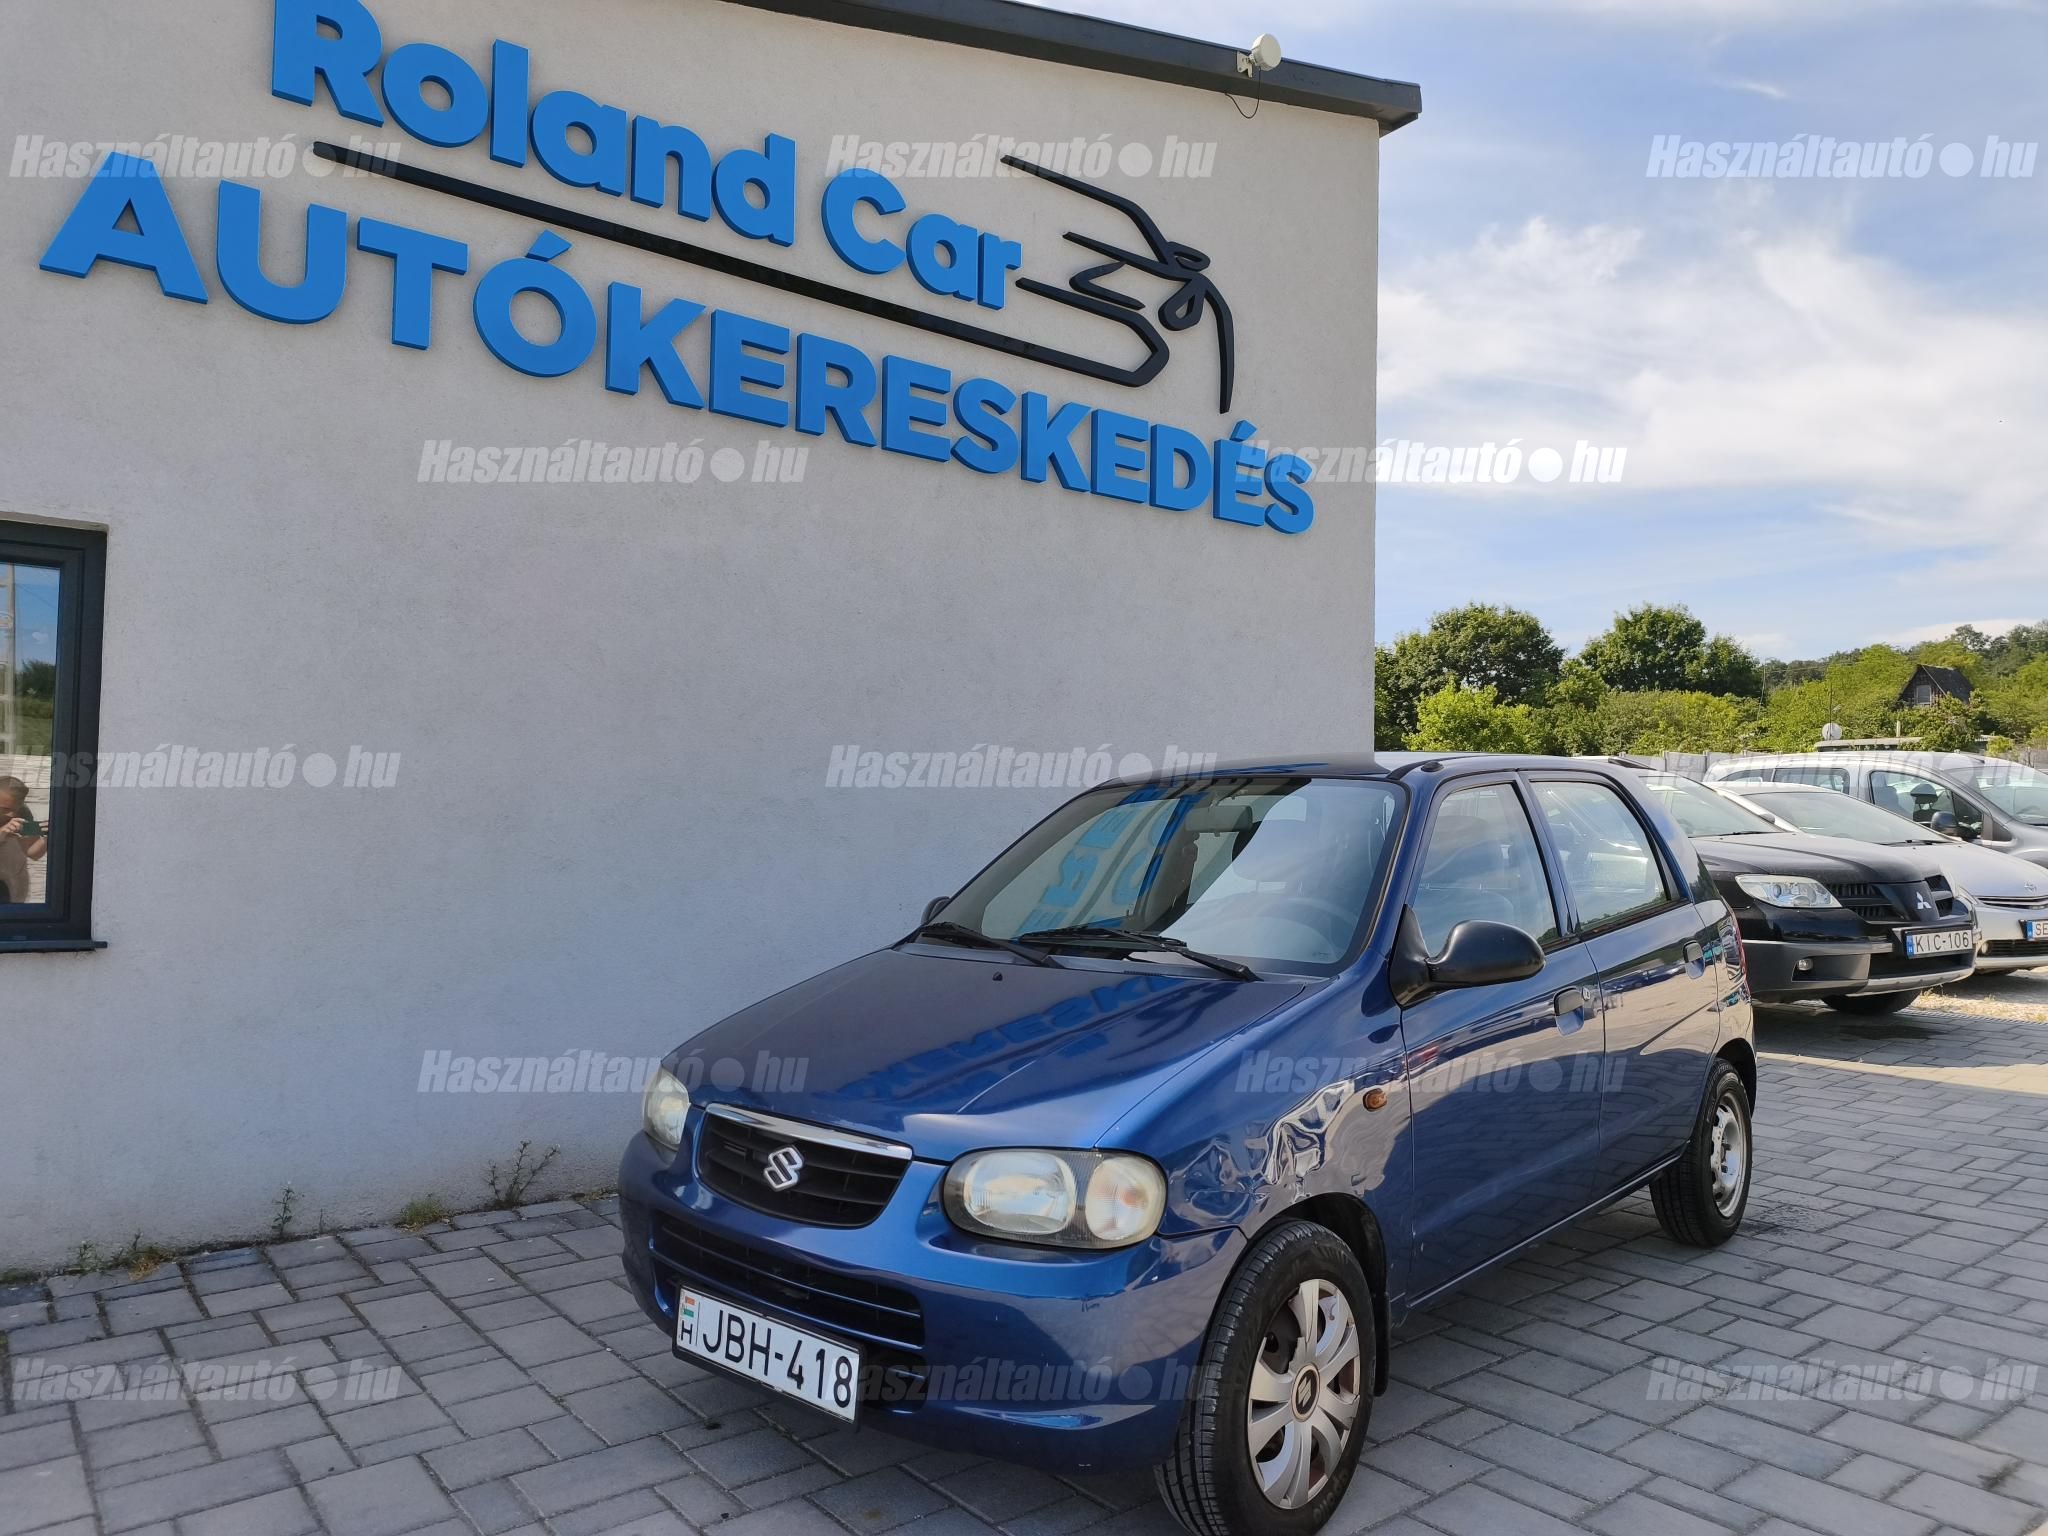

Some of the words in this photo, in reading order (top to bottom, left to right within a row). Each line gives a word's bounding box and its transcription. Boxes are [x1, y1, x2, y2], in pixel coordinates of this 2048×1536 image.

[272, 0, 796, 247] Roland
[820, 167, 1022, 310] Car
[39, 151, 1315, 535] AUTÓKERESKEDÉS
[1915, 932, 1970, 953] KIC-106
[680, 1319, 694, 1345] H
[702, 1309, 853, 1409] JBH-418
